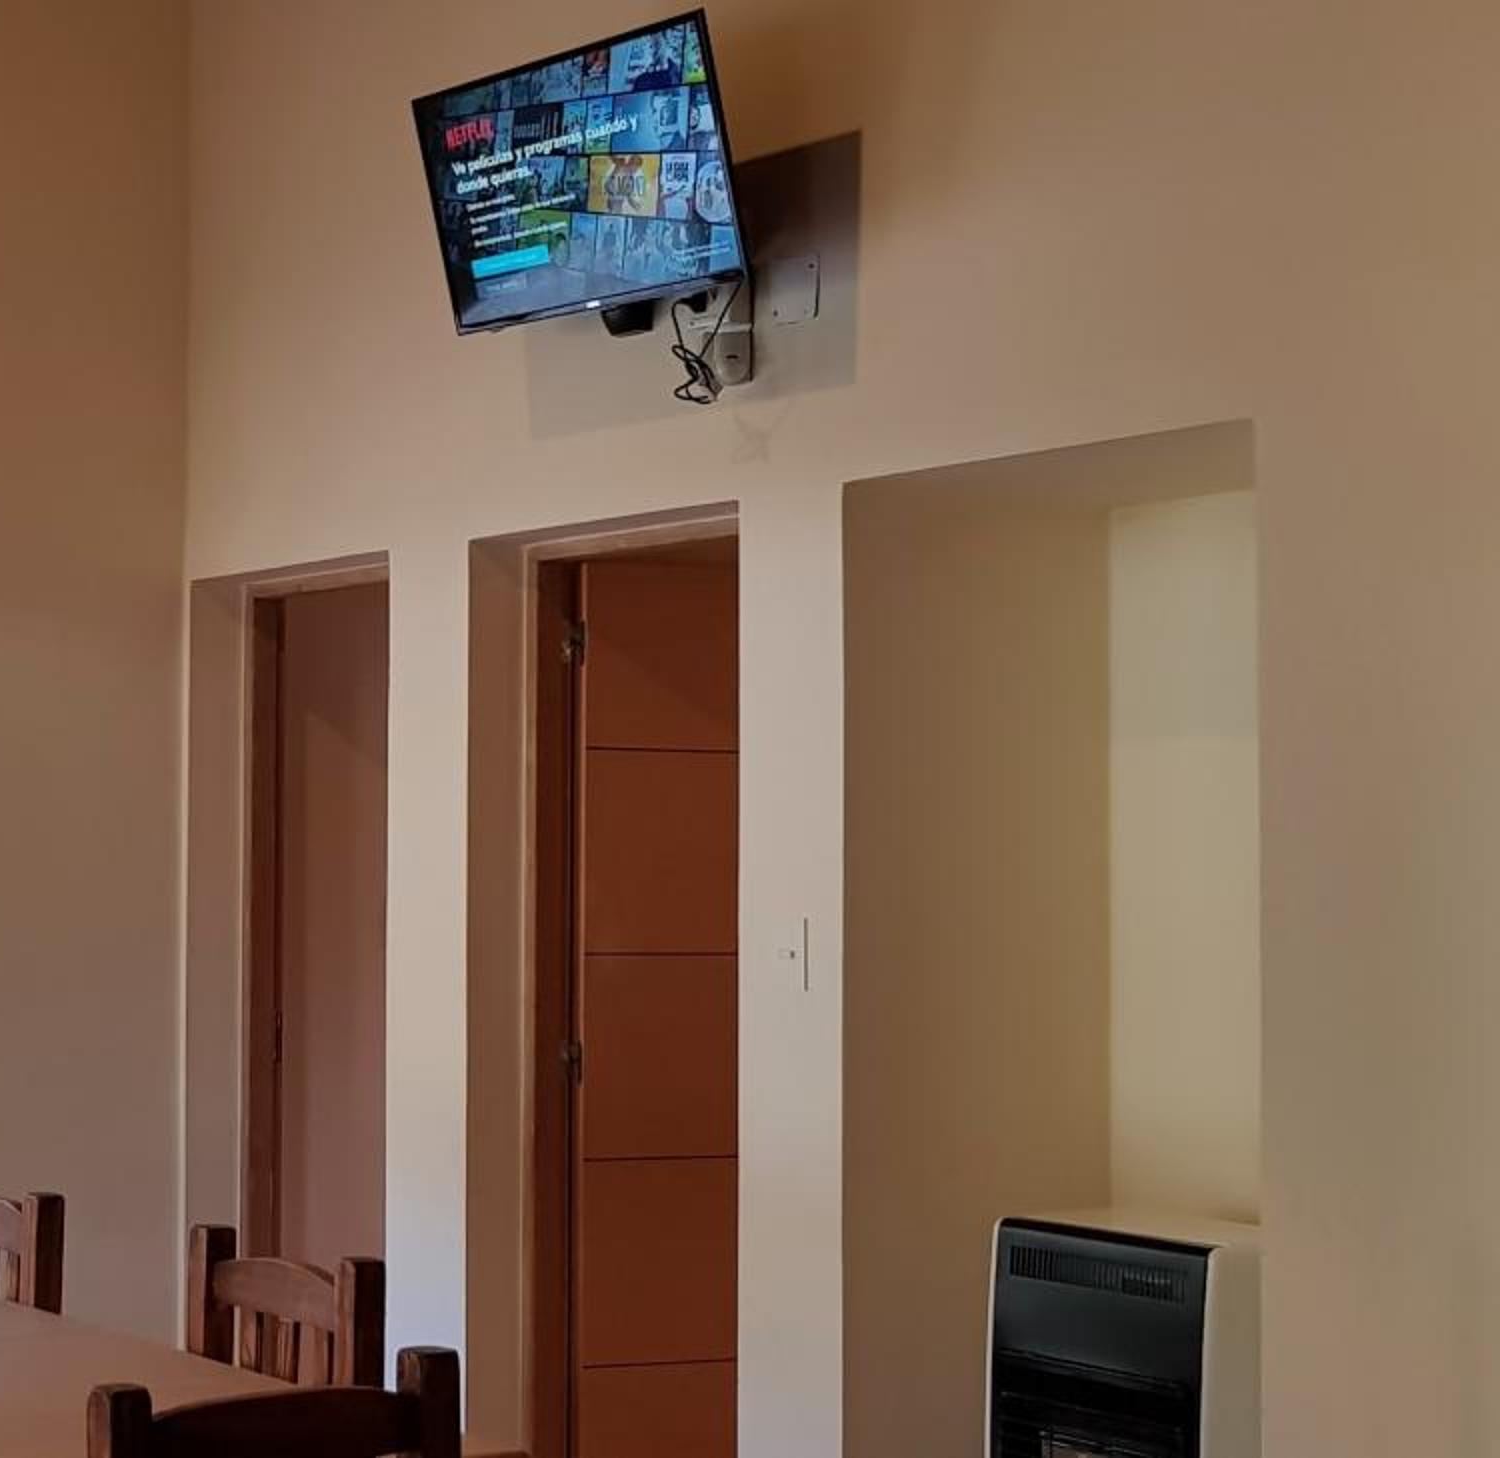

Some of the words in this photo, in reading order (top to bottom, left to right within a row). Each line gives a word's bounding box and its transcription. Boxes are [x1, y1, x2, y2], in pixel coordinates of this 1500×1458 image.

[445, 118, 495, 151] NETFLIX
[451, 161, 467, 177] Ve
[523, 132, 583, 160] programas
[585, 115, 628, 140] cuando
[629, 113, 639, 133] y
[456, 175, 490, 195] donde
